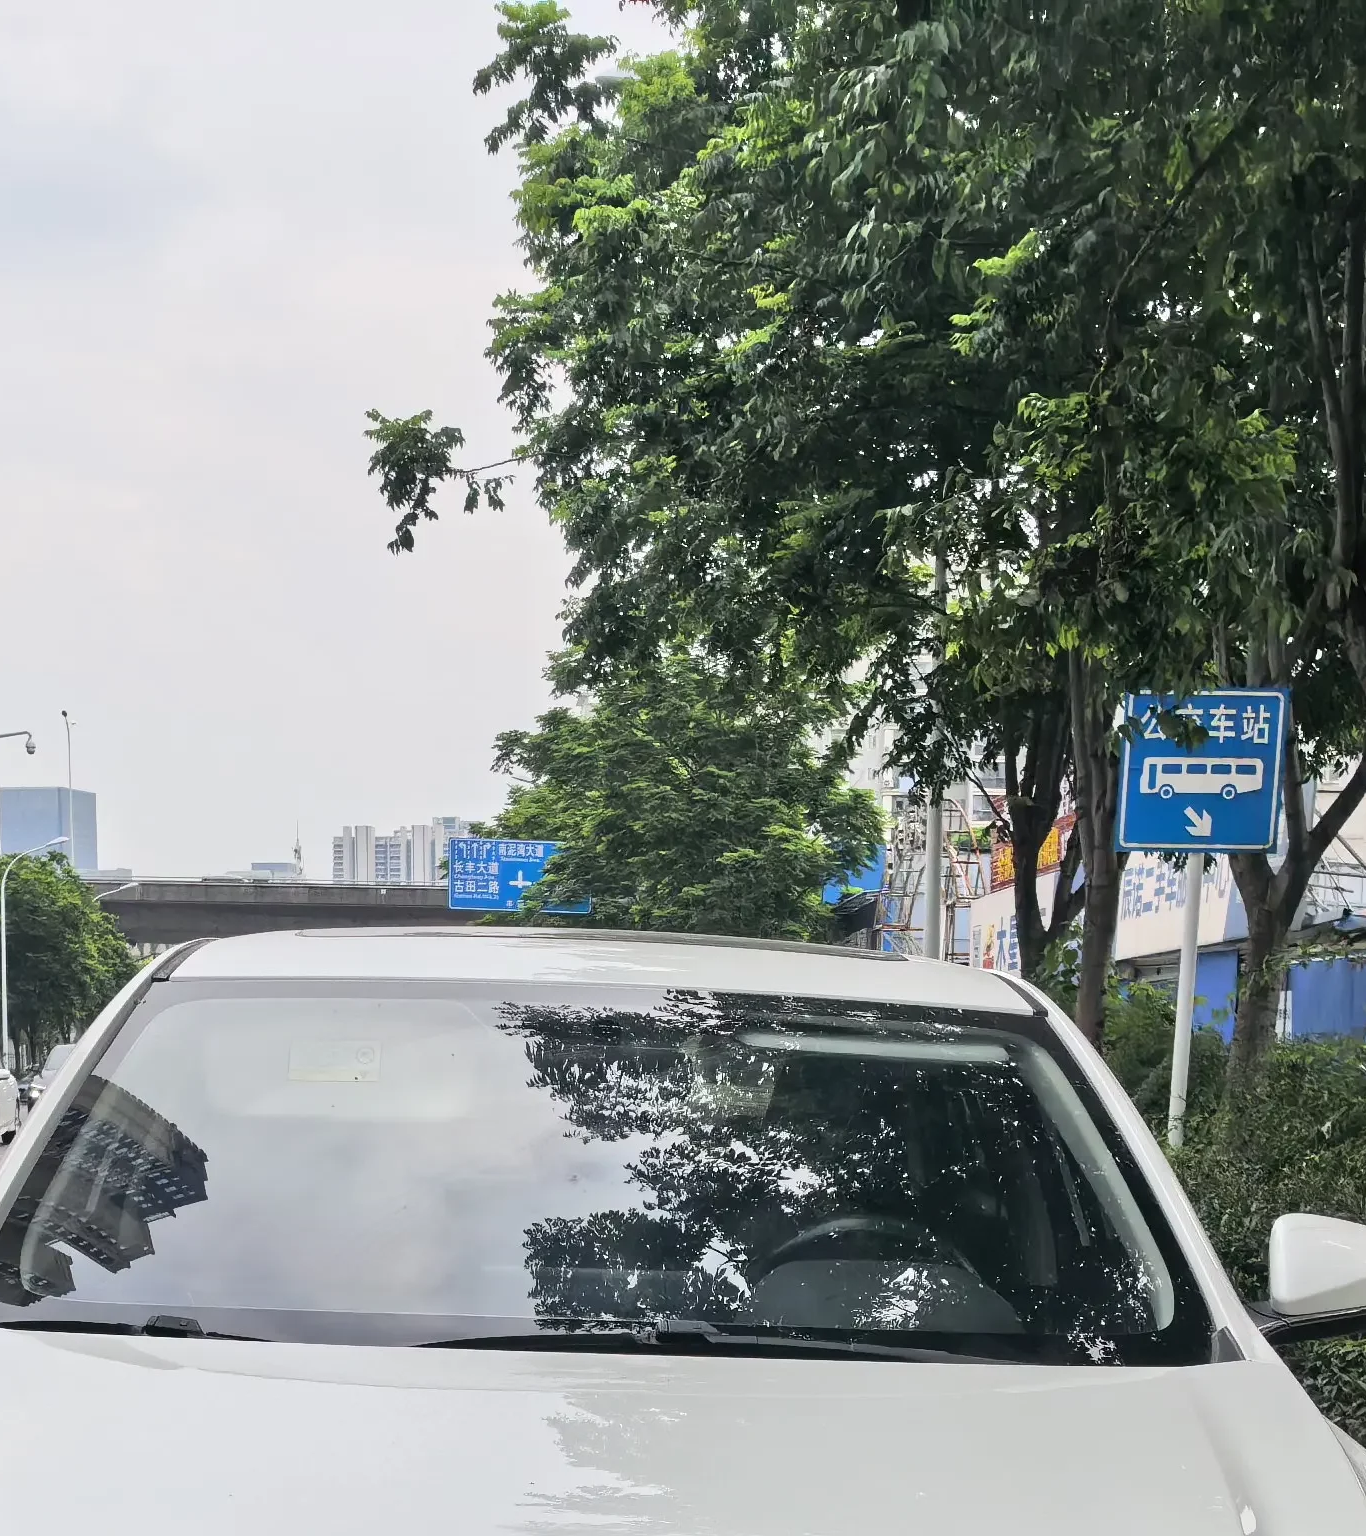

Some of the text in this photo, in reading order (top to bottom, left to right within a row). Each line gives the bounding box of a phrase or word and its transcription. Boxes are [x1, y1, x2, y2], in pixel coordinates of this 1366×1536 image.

[453, 860, 499, 875] 长丰大道
[453, 880, 500, 894] 古田二路
